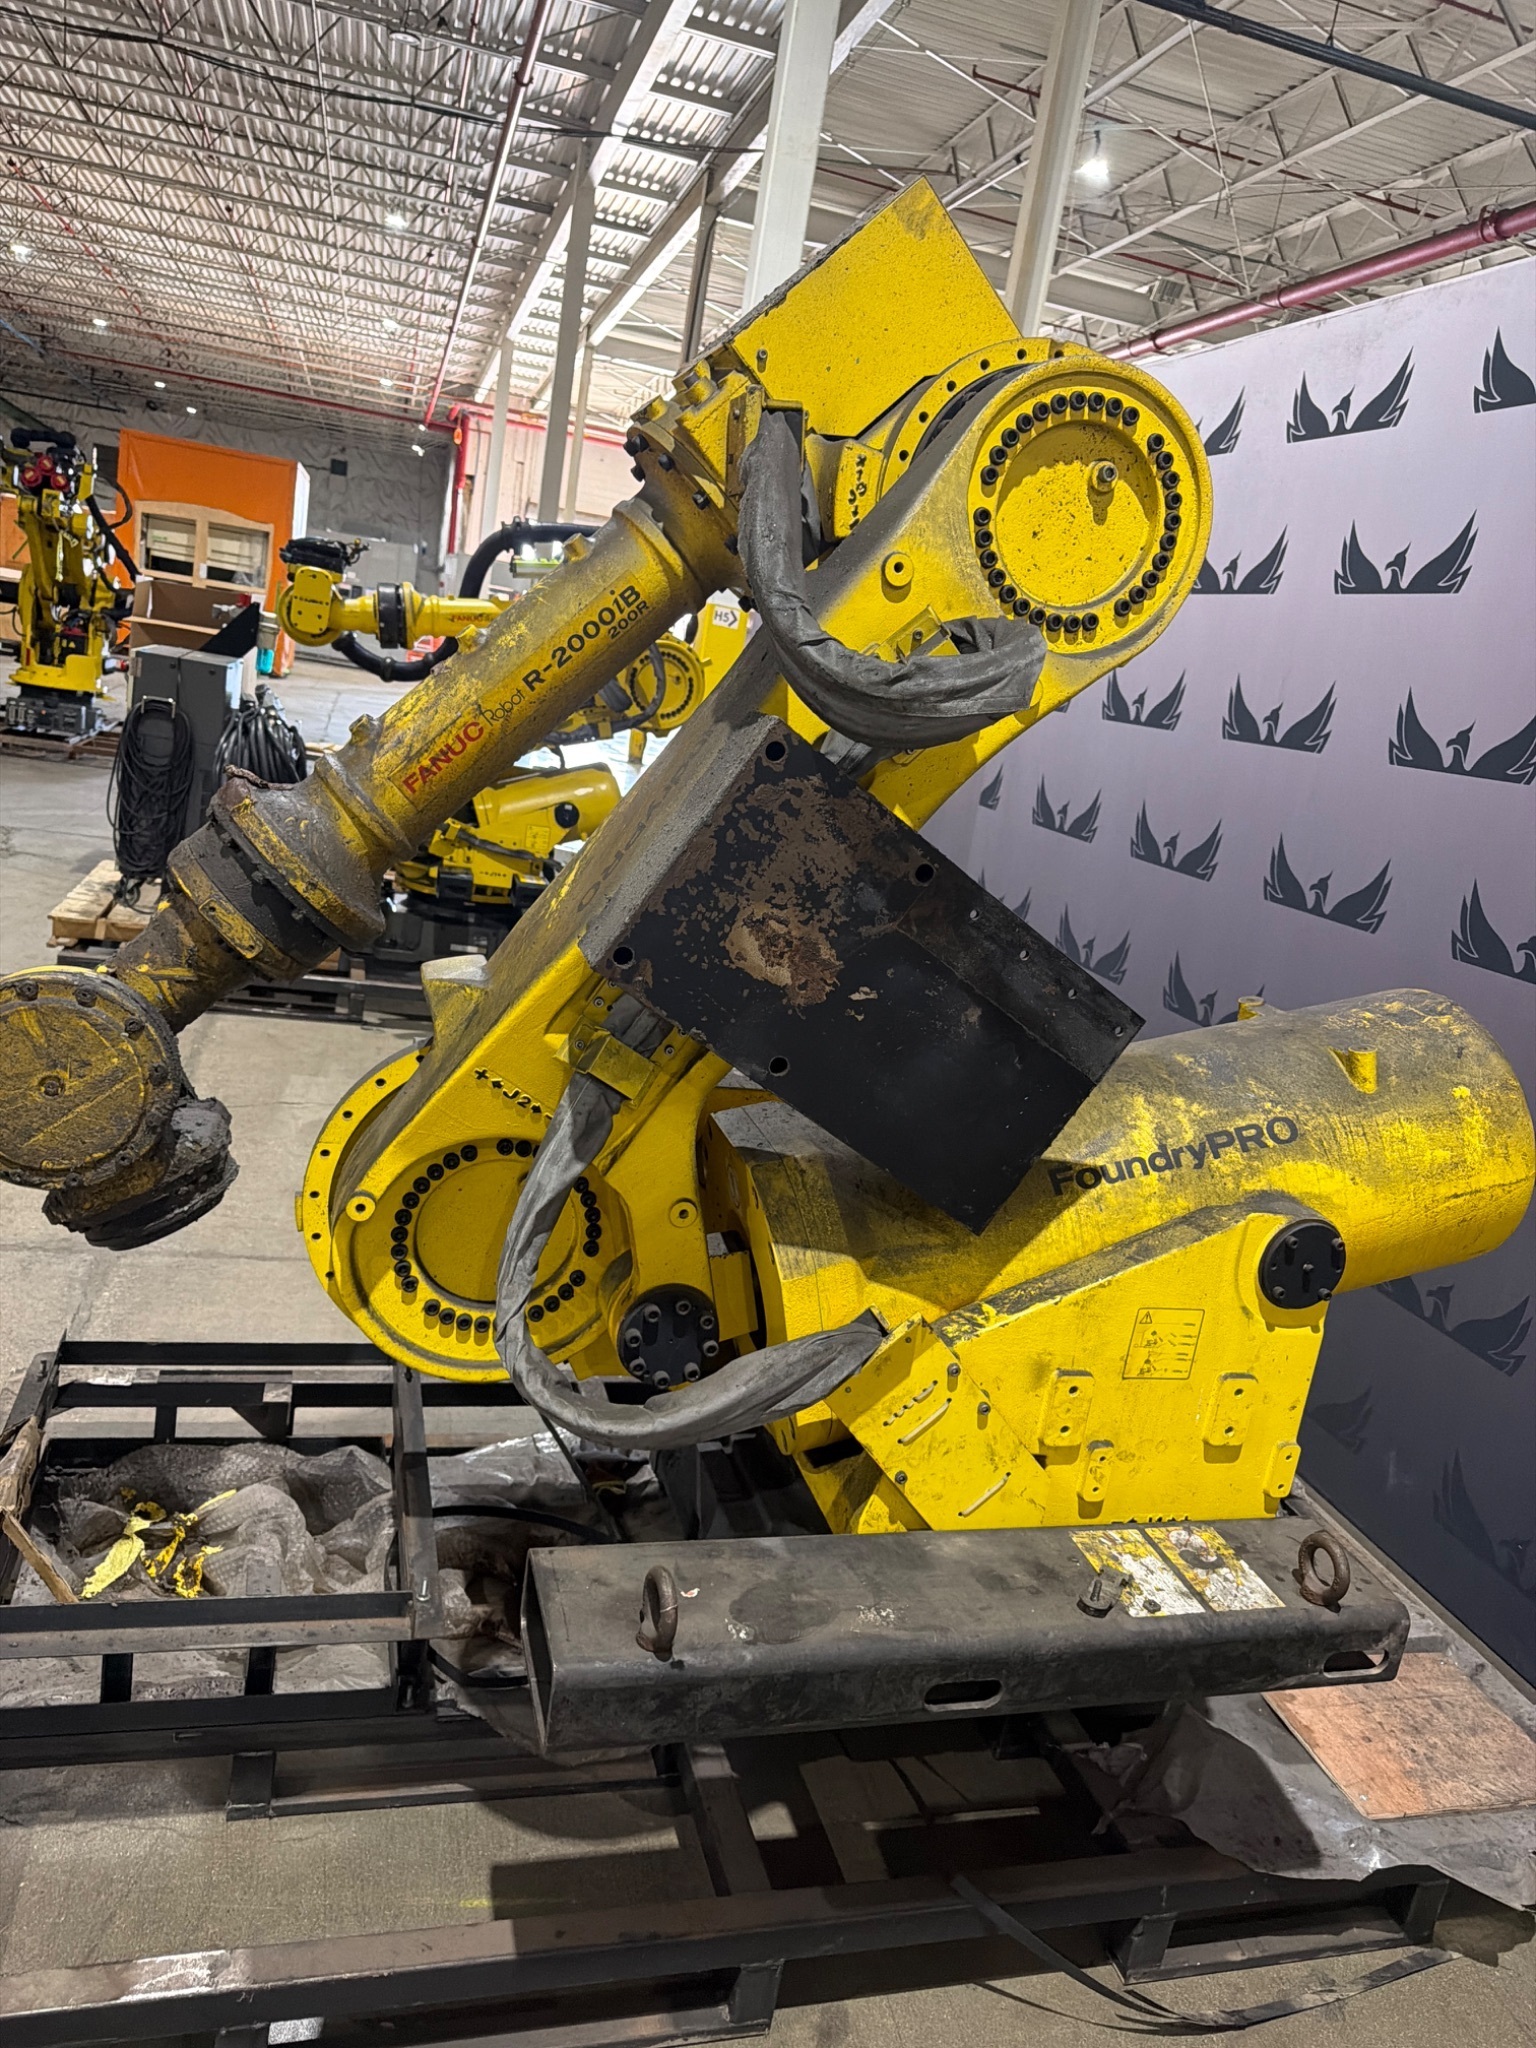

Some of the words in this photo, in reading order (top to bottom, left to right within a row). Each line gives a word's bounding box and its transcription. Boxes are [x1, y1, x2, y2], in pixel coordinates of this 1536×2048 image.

[608, 600, 650, 640] 200R
[403, 721, 484, 795] FANUC
[477, 688, 526, 727] Robot
[1048, 1116, 1299, 1196] FoundryPRO
